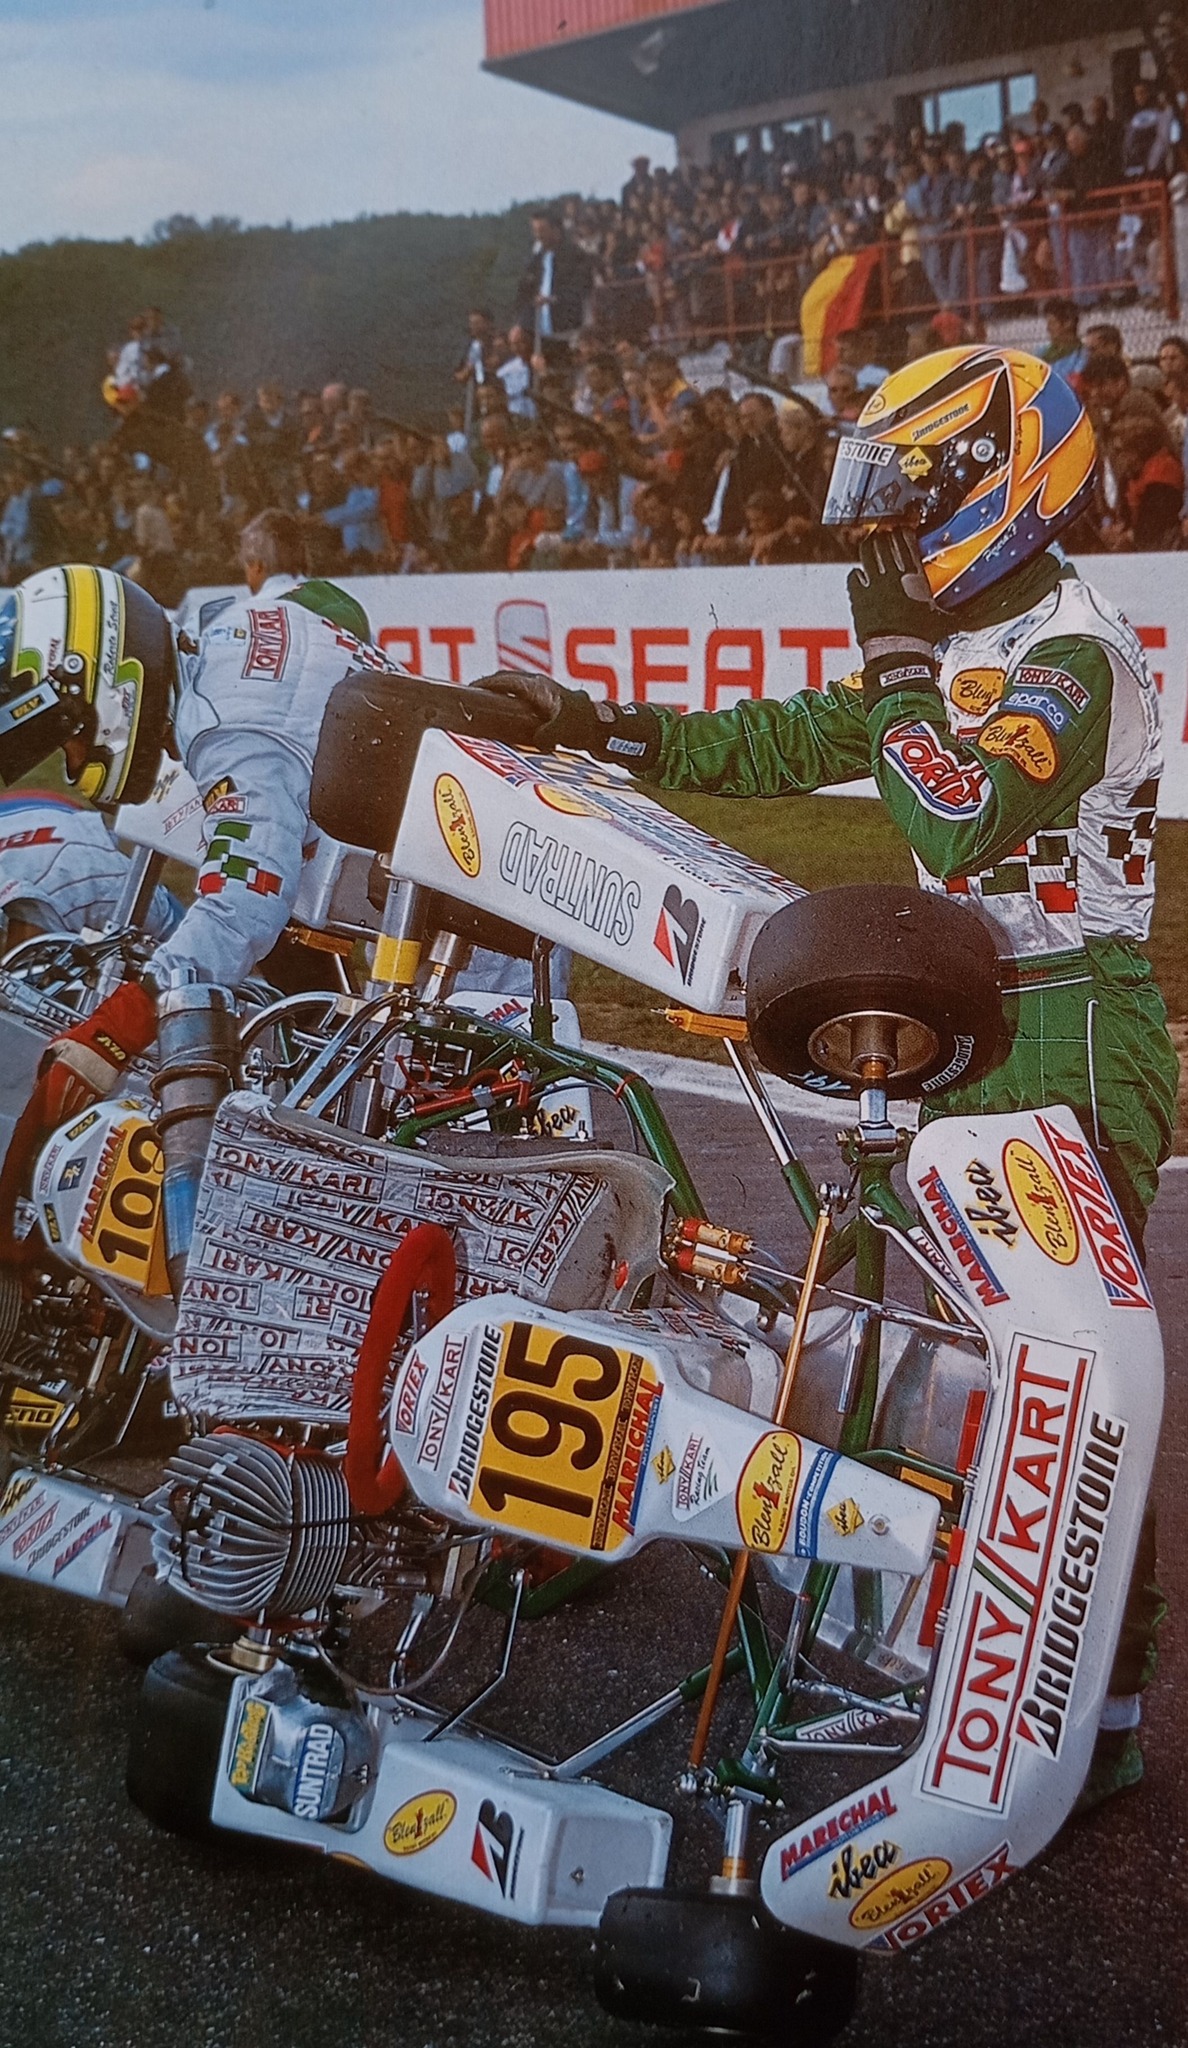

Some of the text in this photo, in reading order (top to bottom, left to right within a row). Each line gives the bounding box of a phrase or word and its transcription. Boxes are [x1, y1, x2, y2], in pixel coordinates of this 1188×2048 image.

[565, 627, 849, 715] SEAT
[1005, 692, 1064, 728] sparco
[500, 821, 642, 947] SUNTRAD
[922, 1035, 975, 1093] BRIDGESTONE
[77, 1125, 129, 1244] MARECHAL
[917, 1165, 1011, 1307] MARECHAL
[1036, 1114, 1153, 1310] VORTEX
[396, 1350, 428, 1435] VORTEX
[449, 1323, 502, 1503] BRIDGESTONE
[479, 1320, 622, 1519] 195
[612, 1379, 666, 1536] MARECHAL
[1015, 1411, 1126, 1757] BRIDGESTONE
[294, 1723, 335, 1821] SUNTRAD
[780, 1786, 898, 1882] MARECHAL
[829, 1840, 901, 1899] ibea
